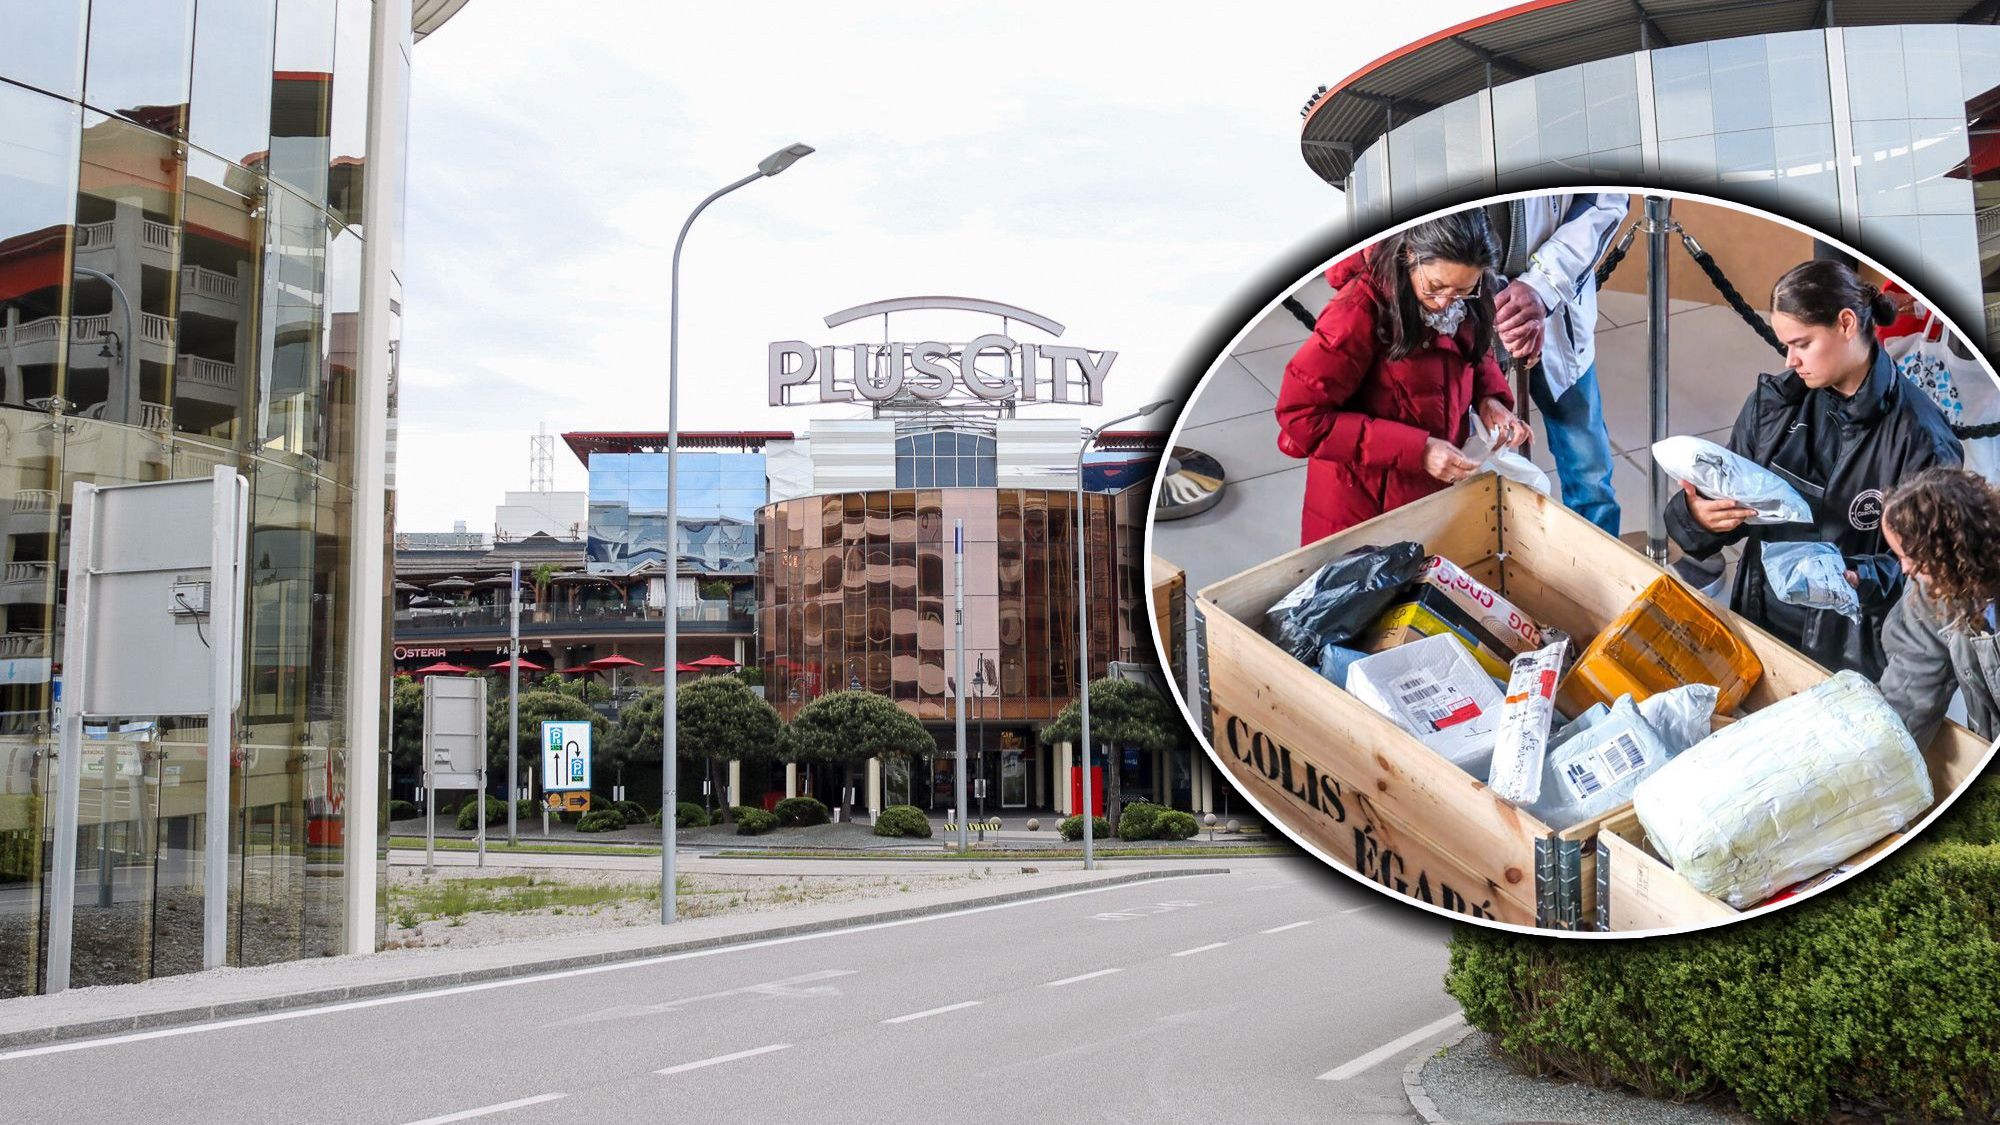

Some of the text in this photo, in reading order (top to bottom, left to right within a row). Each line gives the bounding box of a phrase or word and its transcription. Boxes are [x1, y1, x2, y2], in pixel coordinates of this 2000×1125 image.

[768, 333, 1119, 406] PLUSCITY
[1863, 502, 1875, 511] SK
[394, 646, 446, 660] OSTERIA
[1447, 686, 1457, 694] R
[1226, 715, 1346, 823] COLIS
